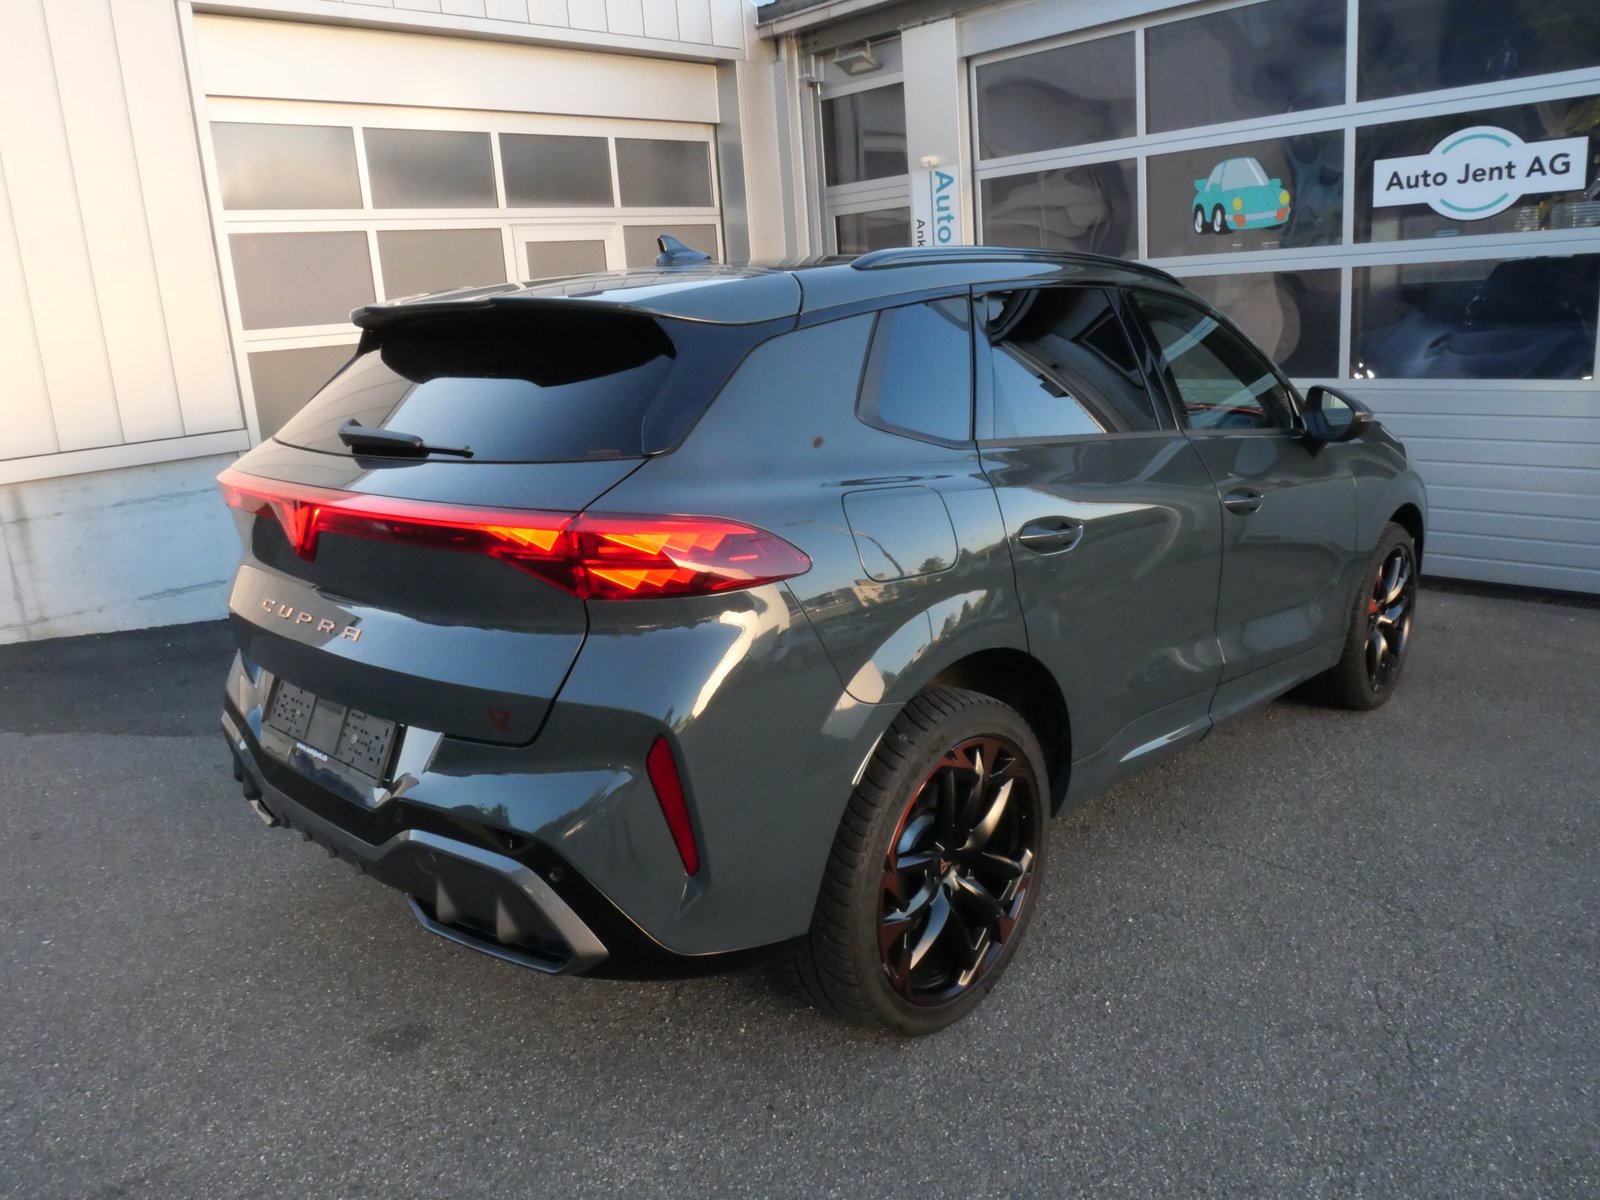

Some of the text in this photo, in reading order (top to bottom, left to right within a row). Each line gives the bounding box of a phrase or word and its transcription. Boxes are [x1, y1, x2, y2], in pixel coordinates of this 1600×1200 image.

[1385, 153, 1571, 191] Auto Jent AG
[935, 170, 955, 244] Auto
[261, 599, 362, 642] CUPRA
